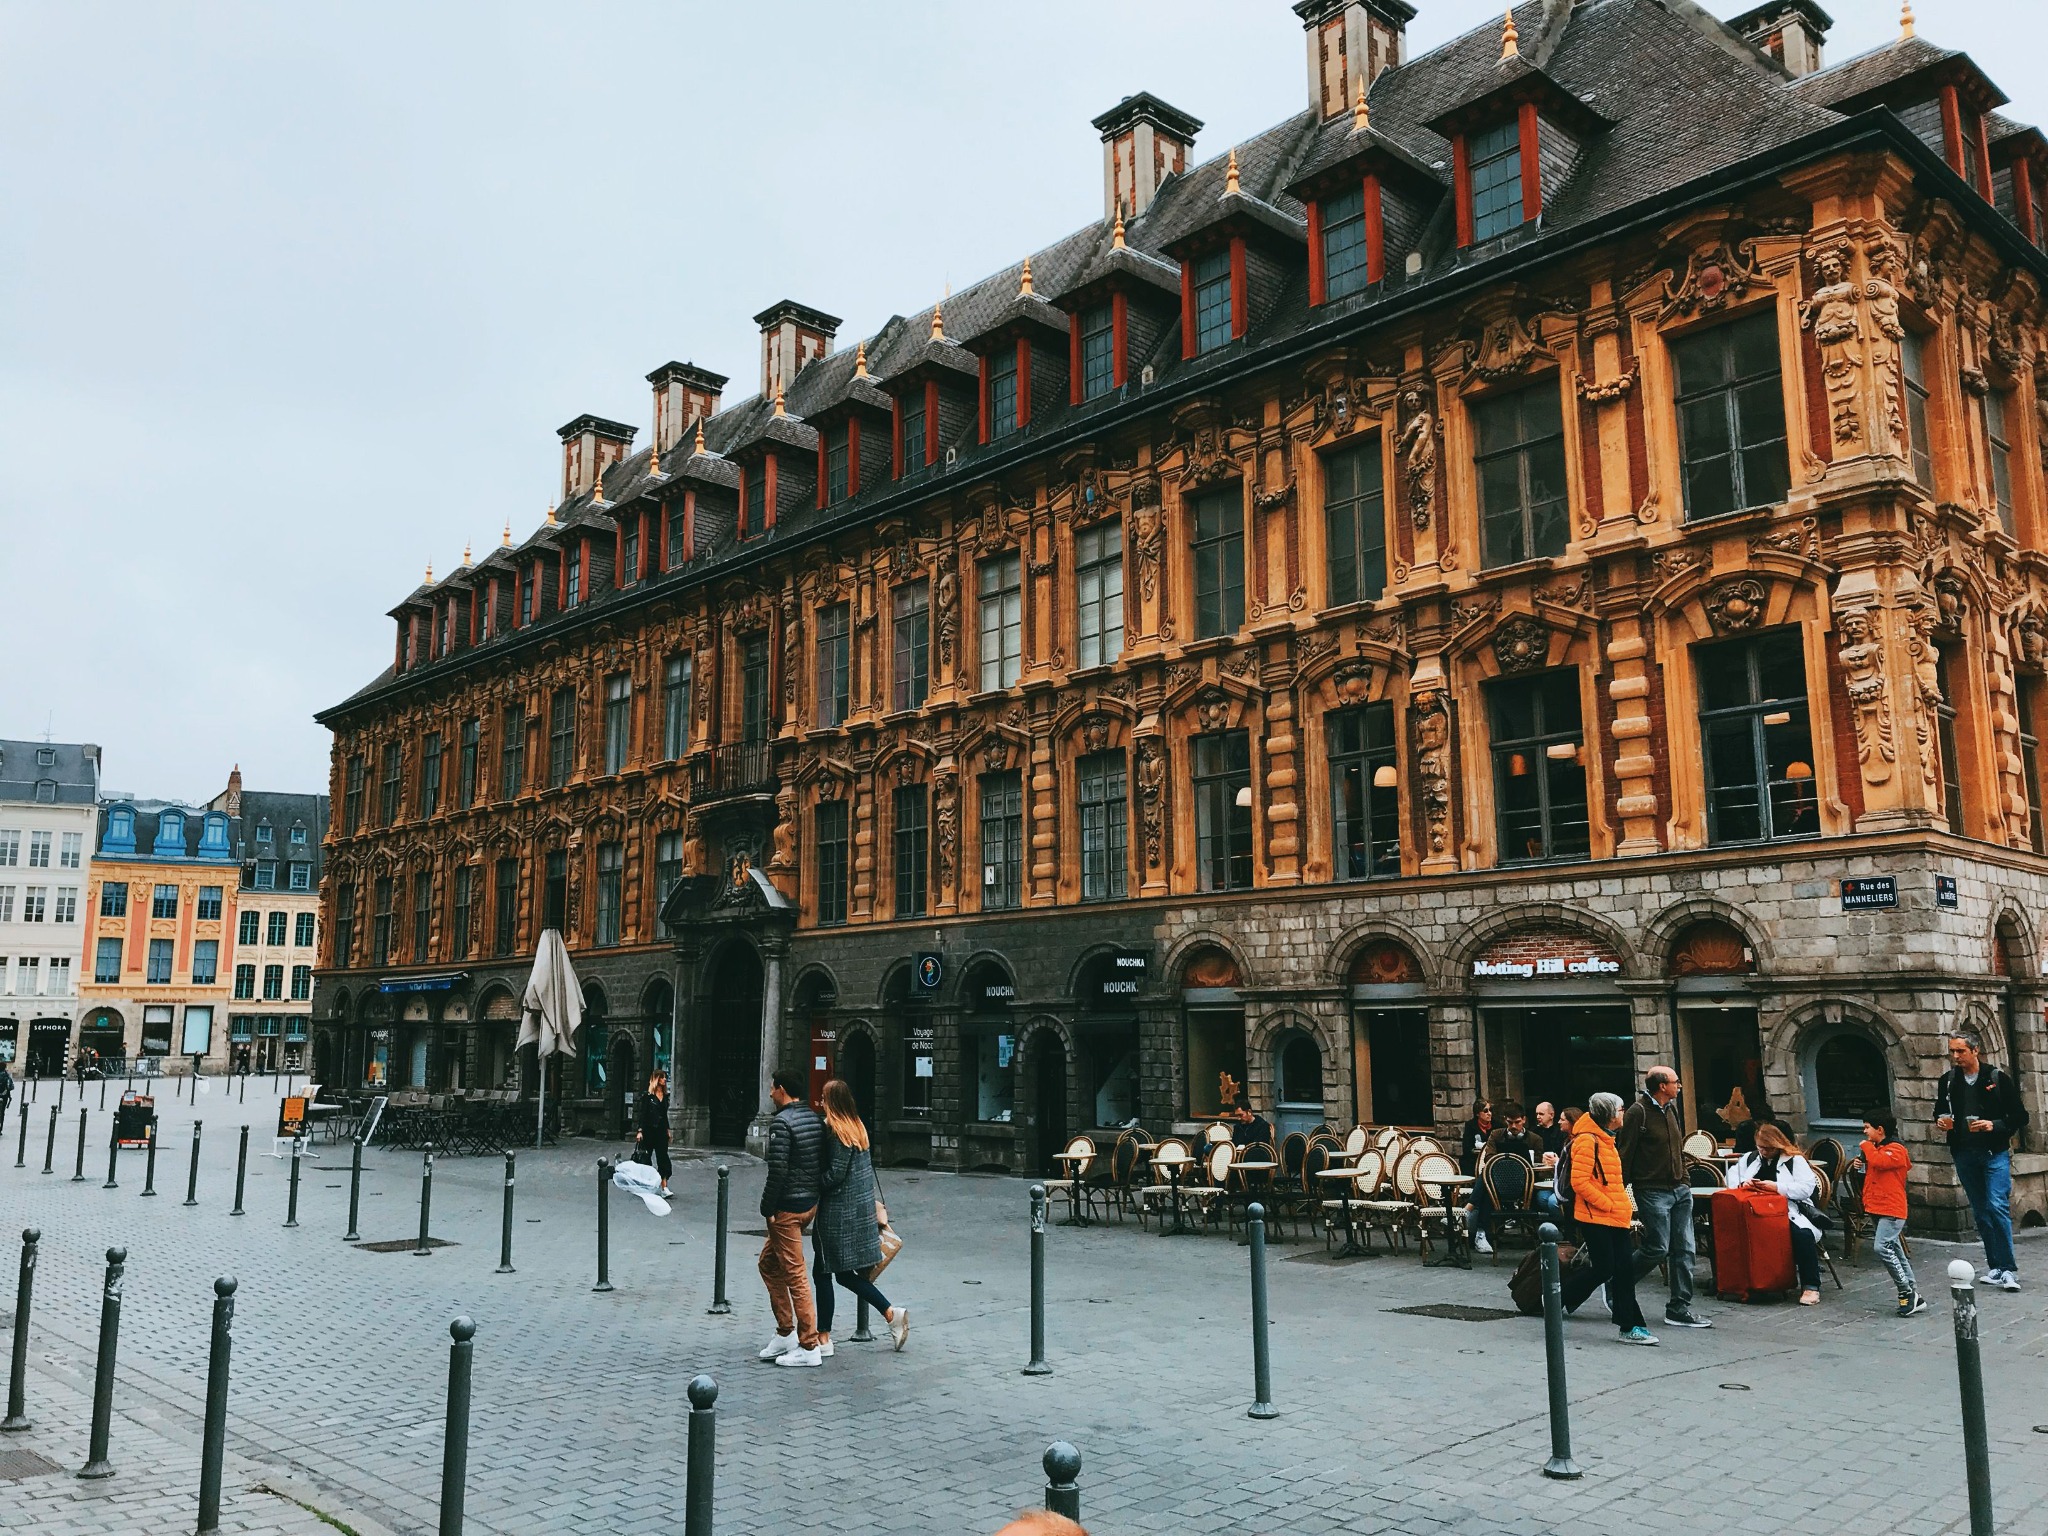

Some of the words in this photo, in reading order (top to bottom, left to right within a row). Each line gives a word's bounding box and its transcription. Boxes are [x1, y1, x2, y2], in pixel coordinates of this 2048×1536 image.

[1860, 882, 1875, 891] Rue
[1877, 881, 1890, 890] des
[1844, 893, 1894, 904] MANNELIERS
[1116, 957, 1145, 967] NOUCHKA
[1473, 960, 1534, 978] Notting
[1536, 959, 1567, 974] Hill
[1568, 957, 1620, 973] coffee
[1103, 981, 1139, 993] NOUCHK
